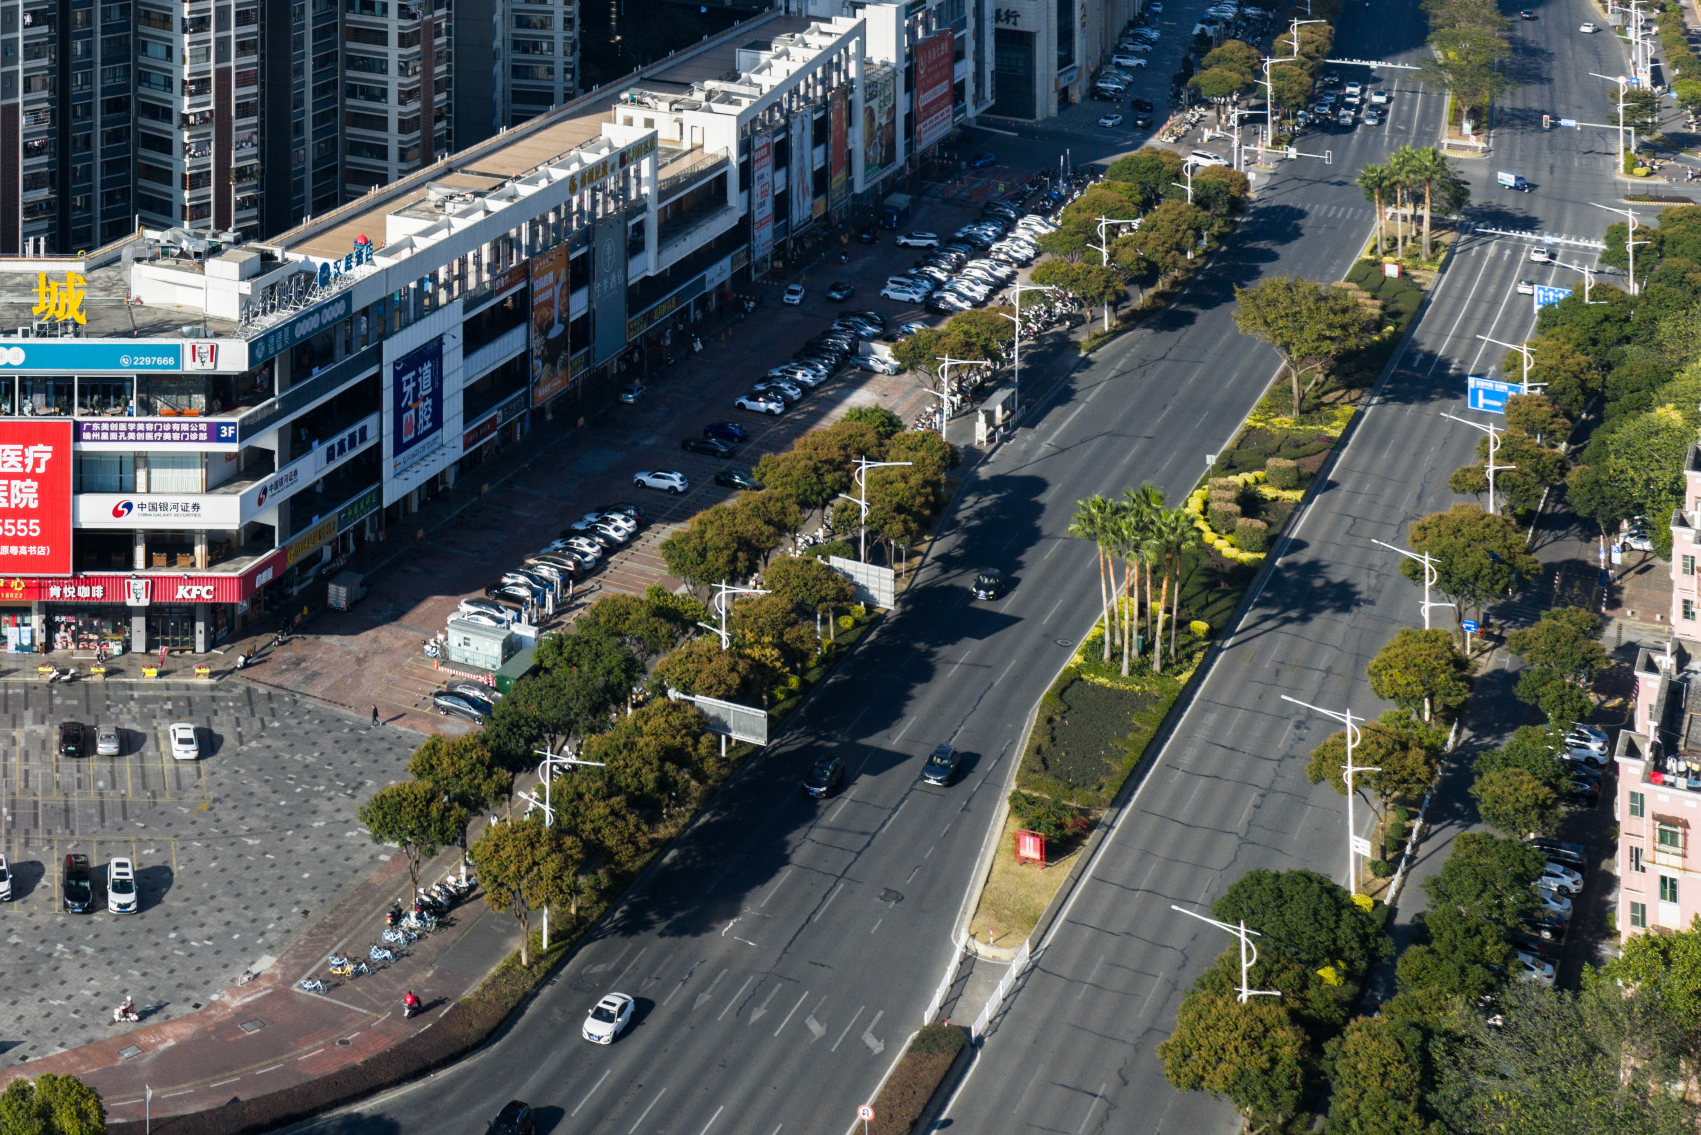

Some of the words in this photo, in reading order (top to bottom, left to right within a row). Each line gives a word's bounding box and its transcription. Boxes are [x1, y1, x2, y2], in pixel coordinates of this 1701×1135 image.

[333, 239, 373, 279] 汉庭酒店
[596, 268, 624, 299] 全季酒店
[133, 357, 174, 366] 2297666
[83, 422, 208, 432] 广东美创医学美容门诊有限公司
[220, 426, 236, 438] 3F
[82, 432, 208, 441] 端州星面孔美创医疗美容门诊部
[137, 502, 201, 513] 中国银河证券
[49, 585, 104, 599] 肯悦咖啡
[175, 586, 215, 599] KFC
